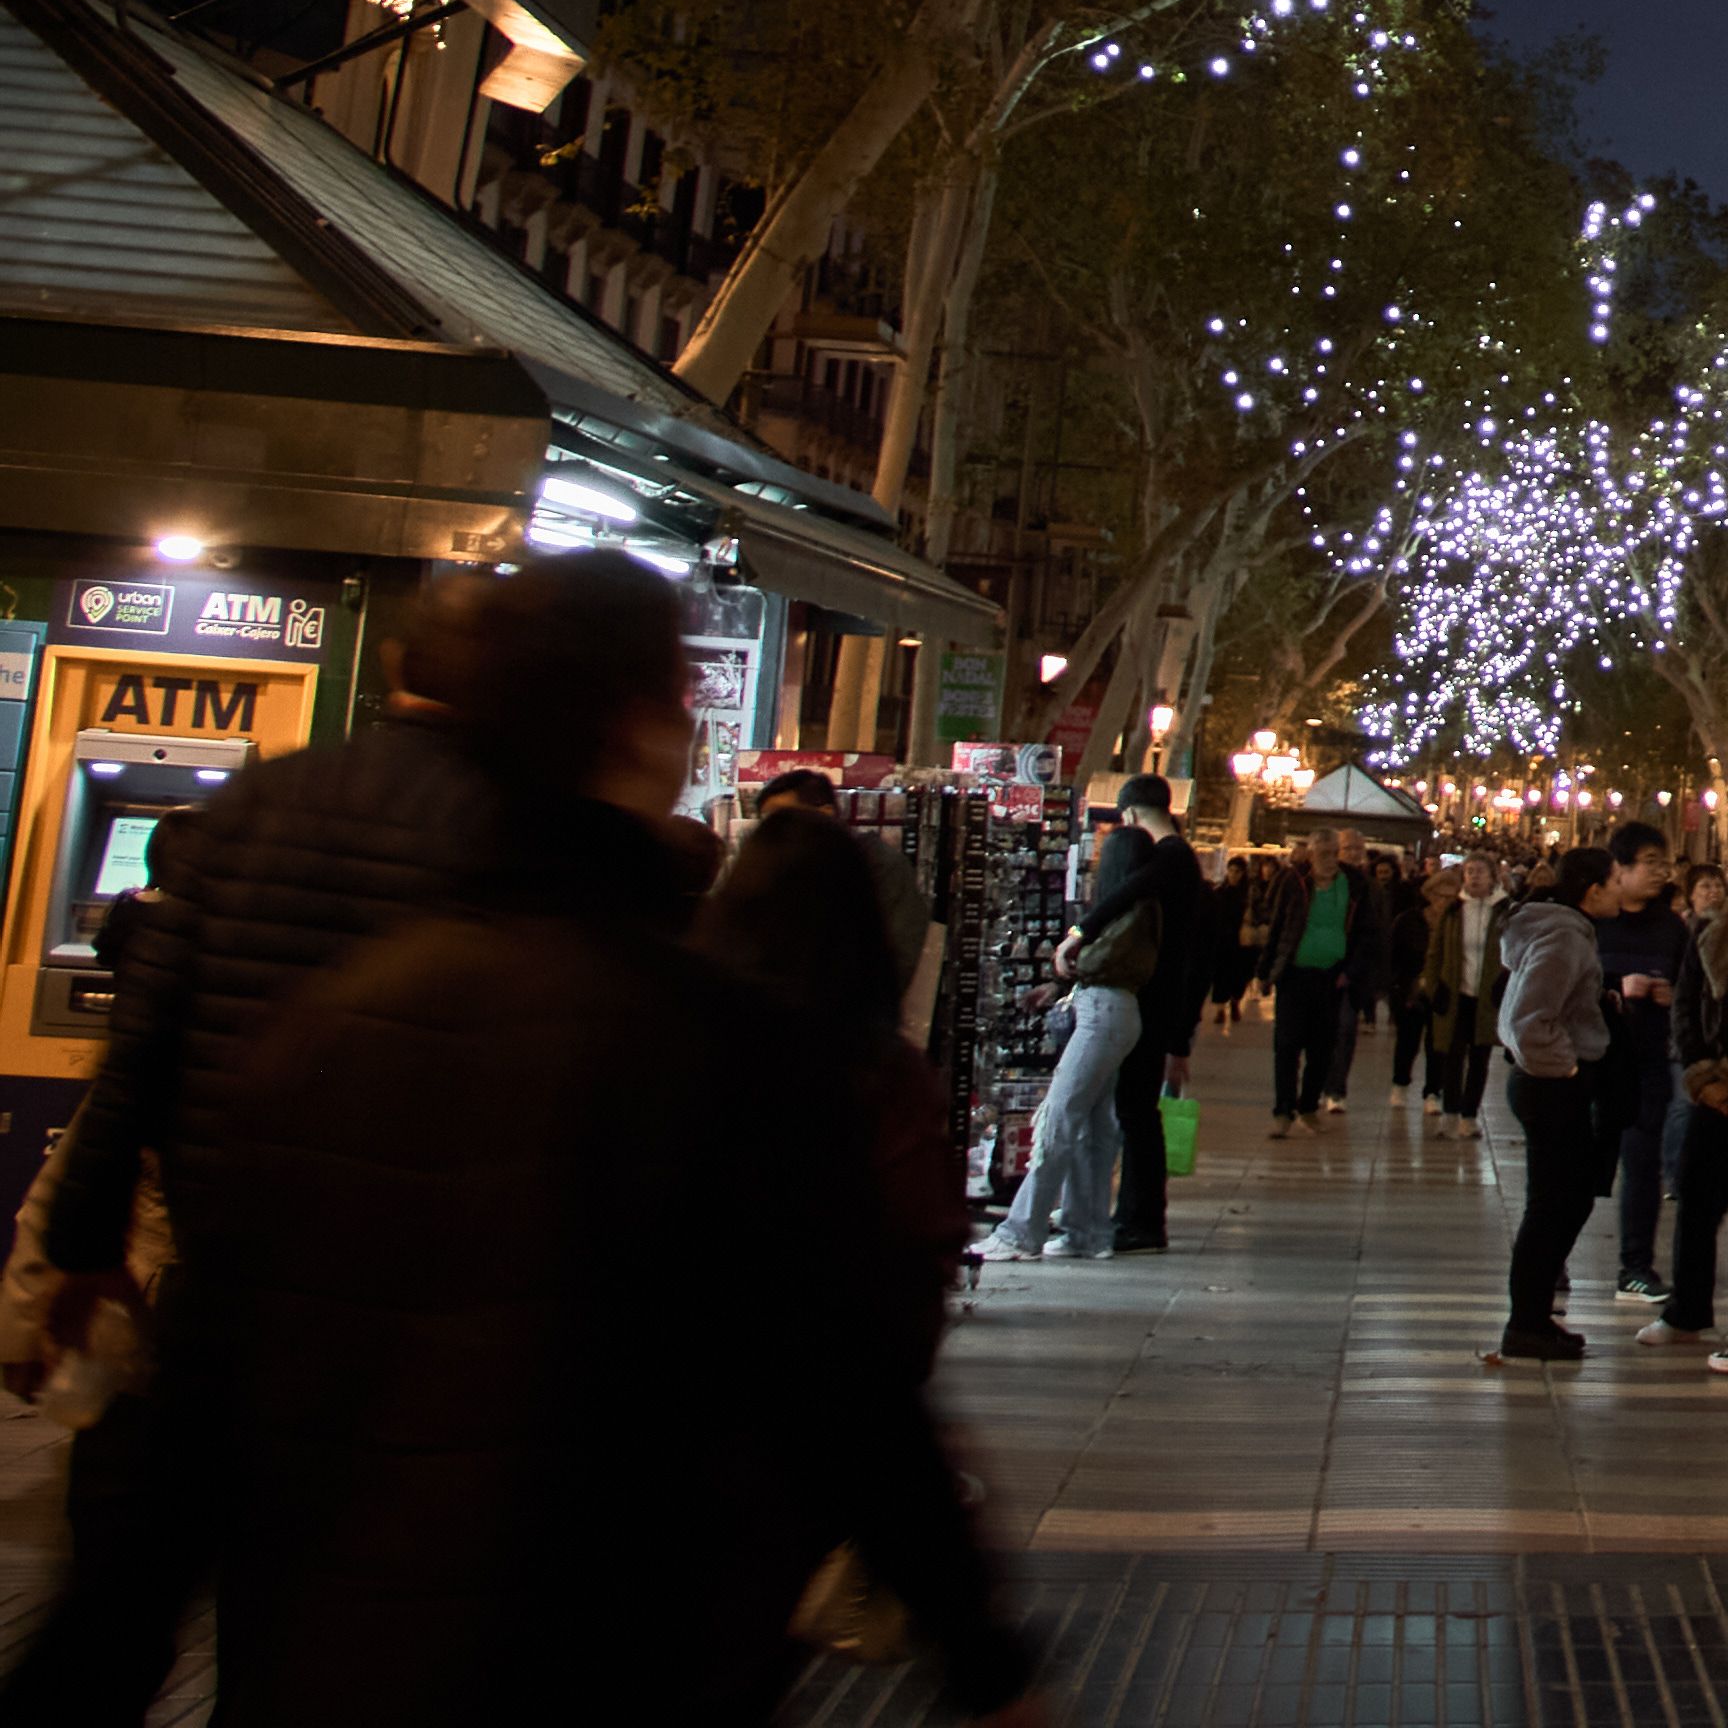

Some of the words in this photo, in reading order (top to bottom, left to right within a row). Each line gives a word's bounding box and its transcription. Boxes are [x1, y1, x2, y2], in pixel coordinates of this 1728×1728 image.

[117, 590, 162, 607] urban
[116, 605, 162, 616] SERVICE
[200, 592, 282, 624] ATM
[115, 612, 147, 624] POINT
[101, 674, 259, 732] ATM
